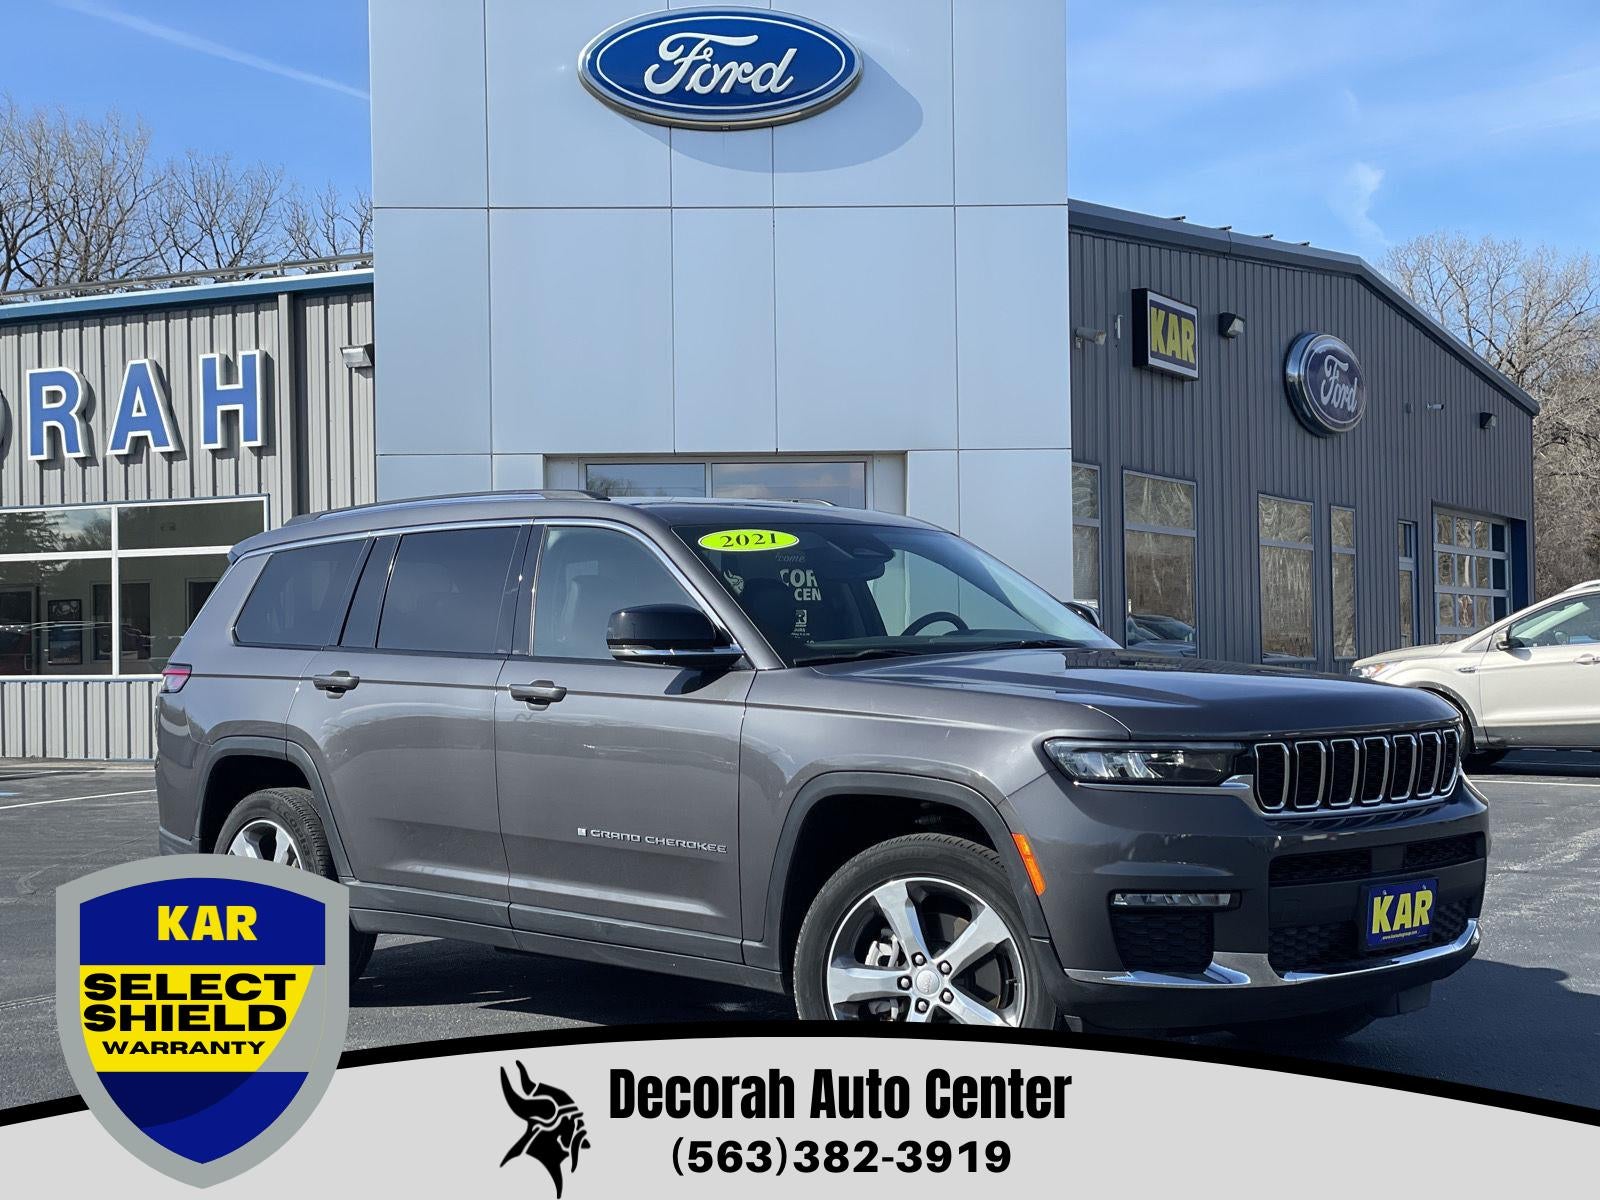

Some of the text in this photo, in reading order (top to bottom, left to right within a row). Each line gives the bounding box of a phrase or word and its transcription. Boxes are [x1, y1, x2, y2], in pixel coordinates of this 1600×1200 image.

[644, 32, 798, 95] Ford
[1149, 306, 1196, 365] KAR
[0, 349, 268, 461] RAH
[1319, 354, 1359, 414] Ford
[720, 532, 777, 548] 2021
[590, 829, 728, 854] GRAND CHEROKEE
[1372, 889, 1433, 934] KAR
